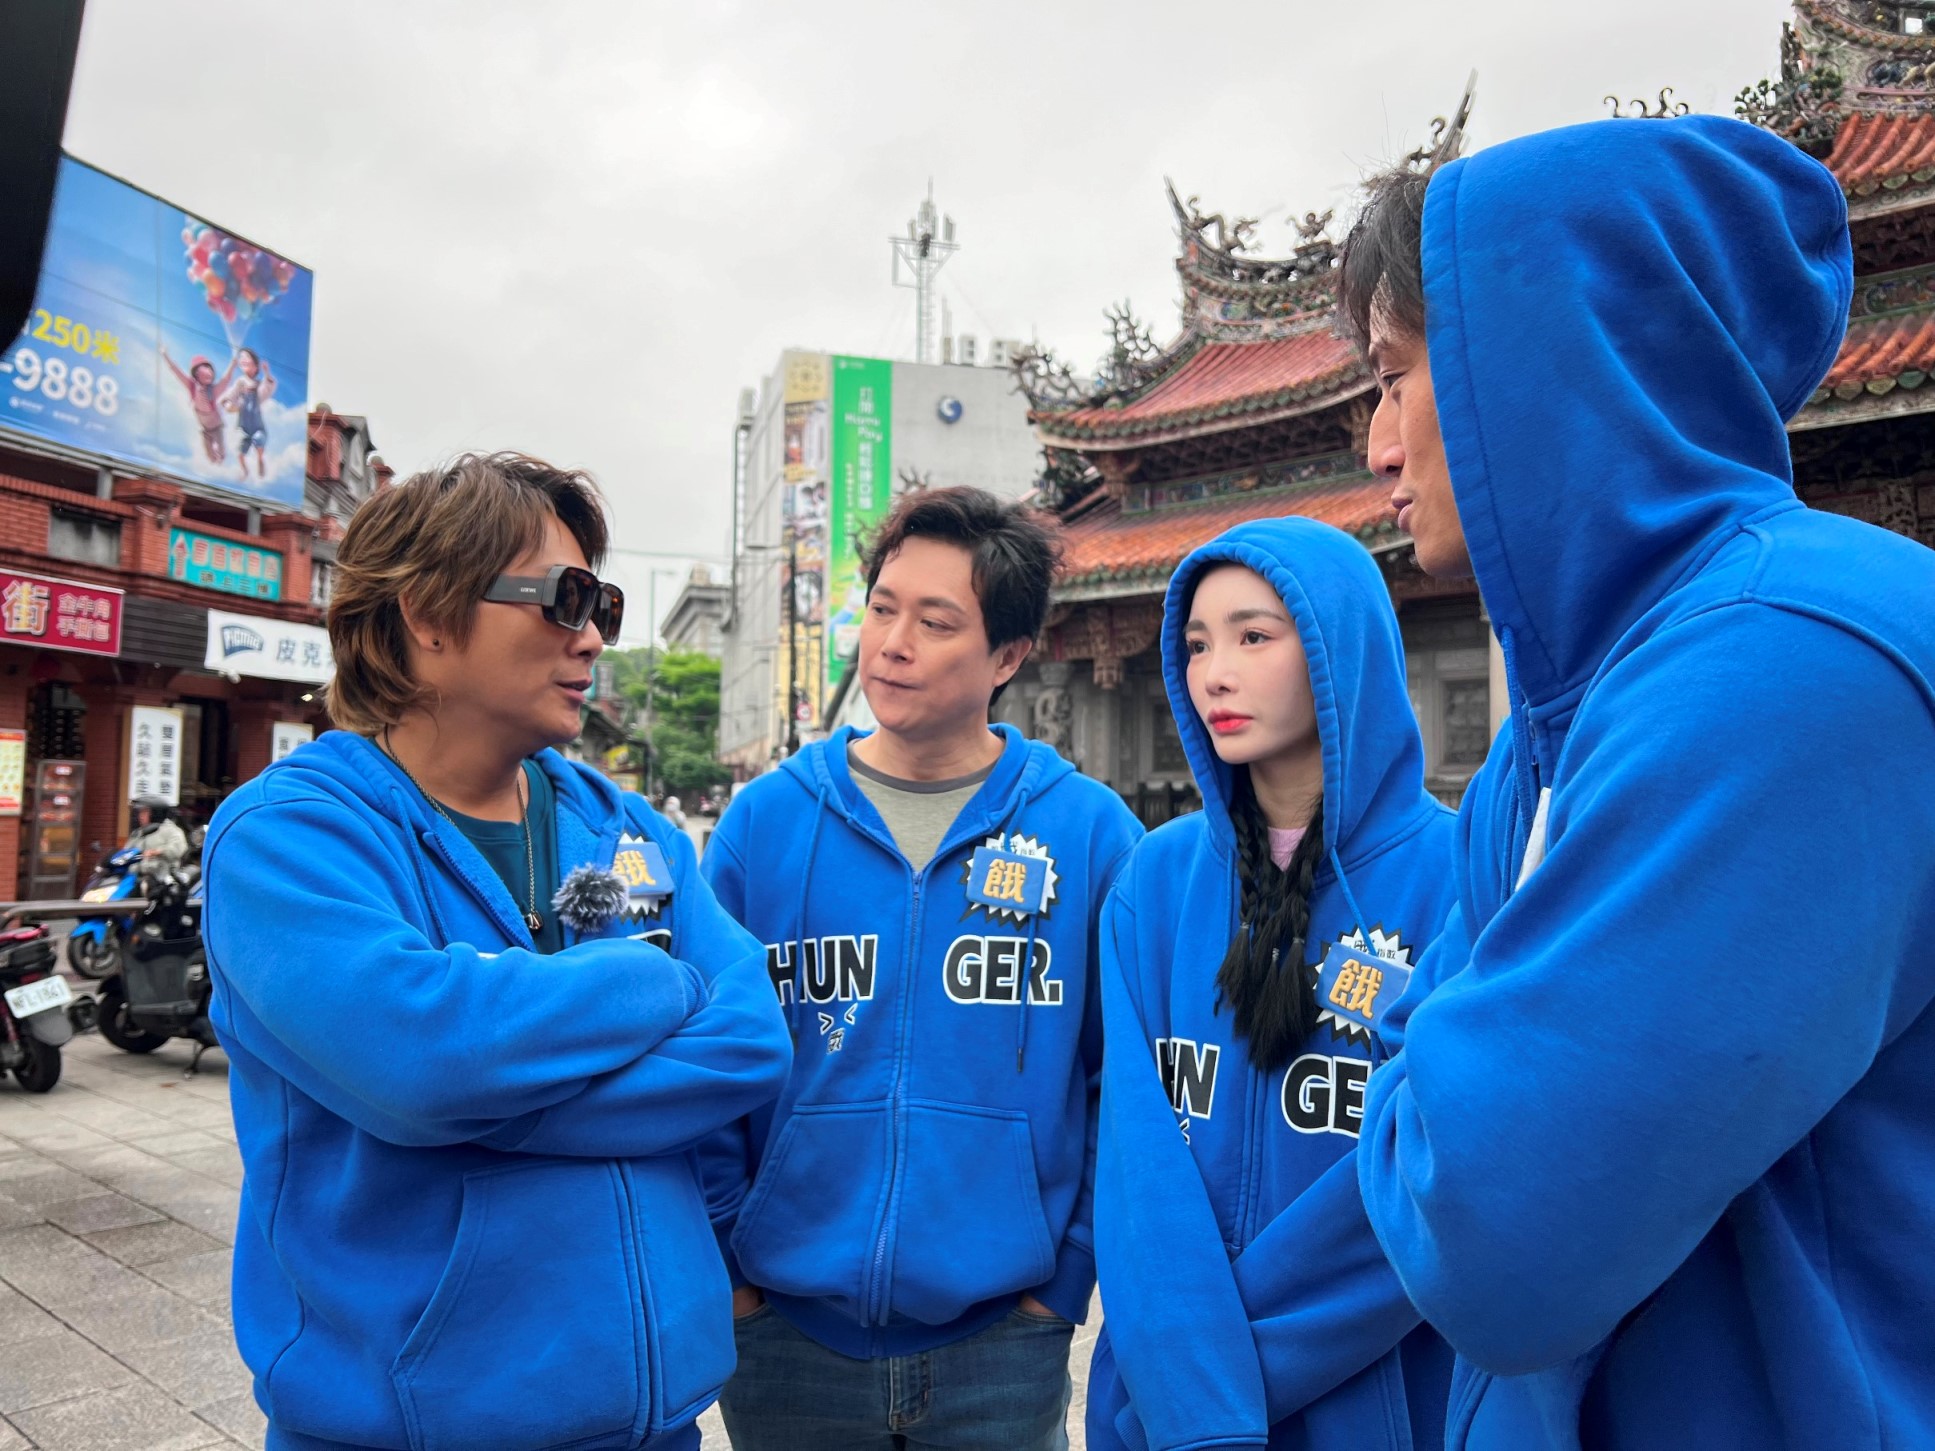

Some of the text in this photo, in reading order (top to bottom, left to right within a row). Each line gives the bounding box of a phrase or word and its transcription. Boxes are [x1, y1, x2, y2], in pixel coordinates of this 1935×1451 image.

[1, 579, 50, 635] 街
[277, 637, 332, 667] 皮克
[983, 858, 1027, 904] 餓
[765, 934, 879, 1006] HUN
[942, 934, 1064, 1005] GER.
[1328, 958, 1383, 1020] 餓
